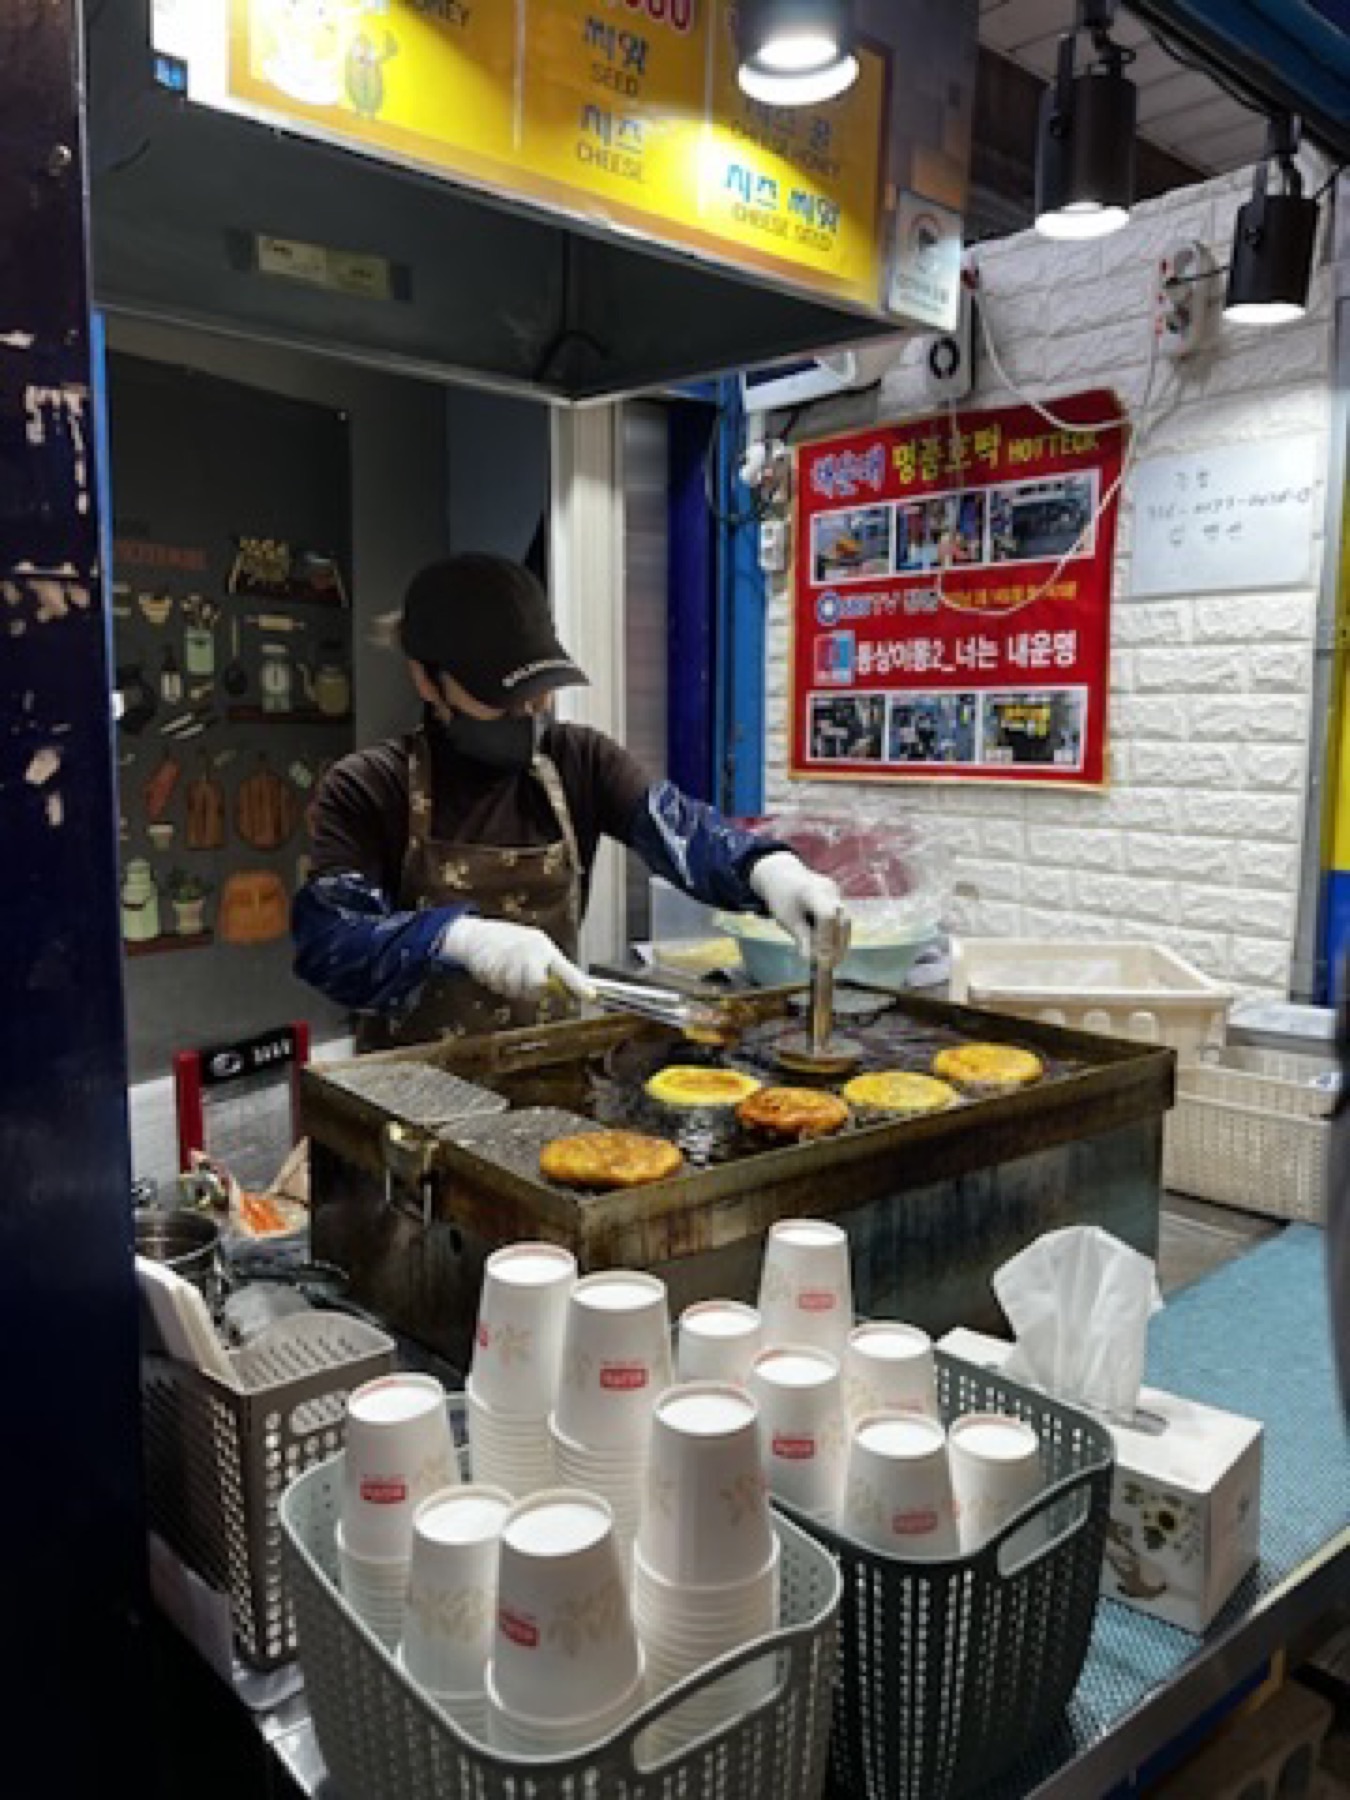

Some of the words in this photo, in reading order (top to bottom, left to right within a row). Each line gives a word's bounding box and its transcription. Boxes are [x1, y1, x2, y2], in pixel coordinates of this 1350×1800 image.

[583, 15, 647, 75] 씨앗
[591, 61, 639, 98] SEED
[579, 103, 643, 154] 치즈
[577, 138, 645, 185] CHEESE
[723, 163, 777, 212] 치즈
[787, 186, 840, 234] 씨앗
[731, 200, 789, 242] CHEESE
[794, 221, 835, 253] SEED
[1006, 629, 1078, 669] 내운명
